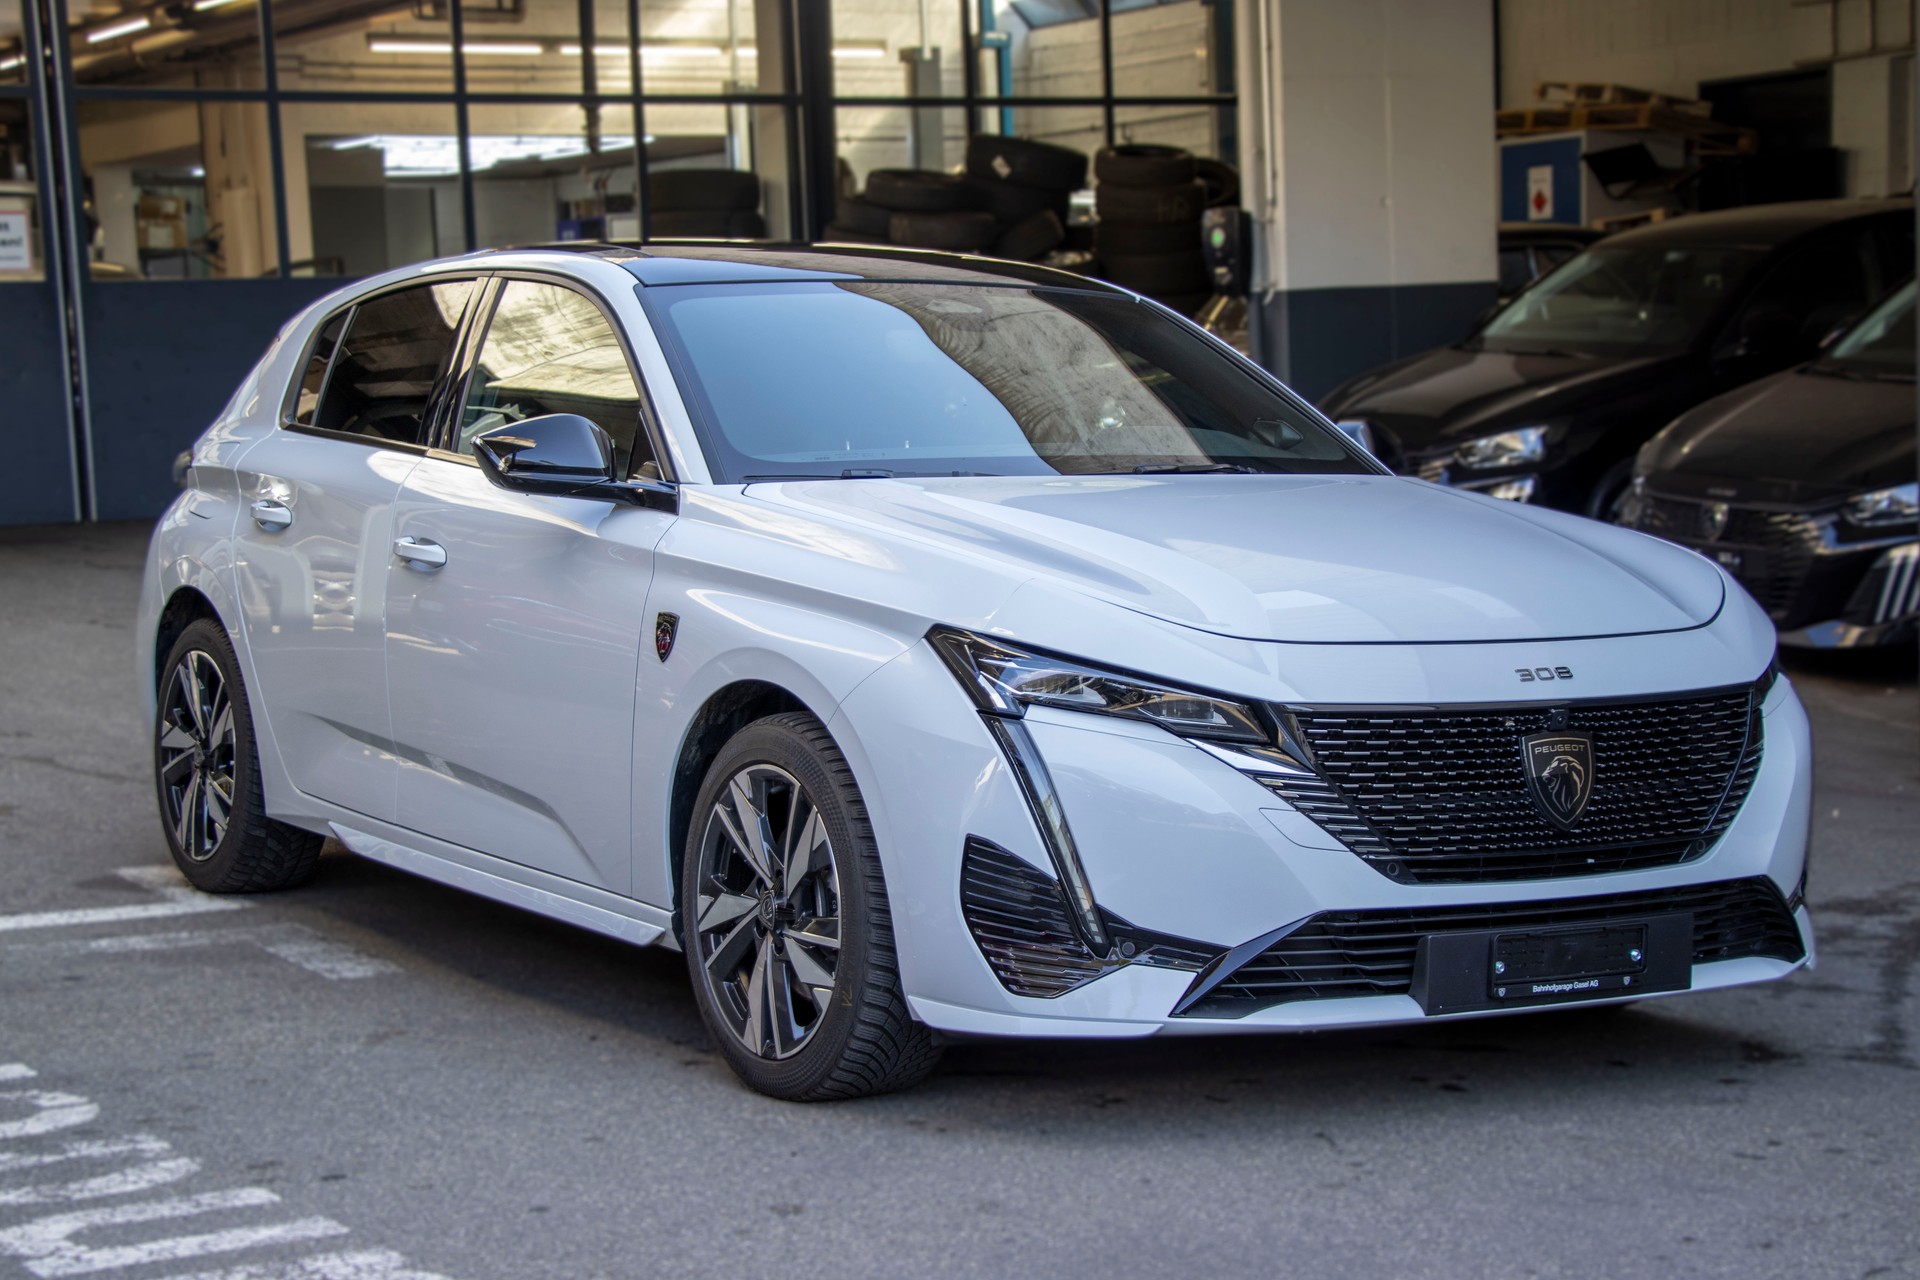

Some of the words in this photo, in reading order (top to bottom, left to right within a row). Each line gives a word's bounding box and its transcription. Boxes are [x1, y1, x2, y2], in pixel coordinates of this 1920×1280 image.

[1514, 666, 1574, 682] 308
[1534, 744, 1585, 755] PEUGEOT
[1532, 983, 1573, 992] Bahnhofgarage
[1574, 981, 1589, 989] Gasel
[1590, 979, 1599, 987] AG
